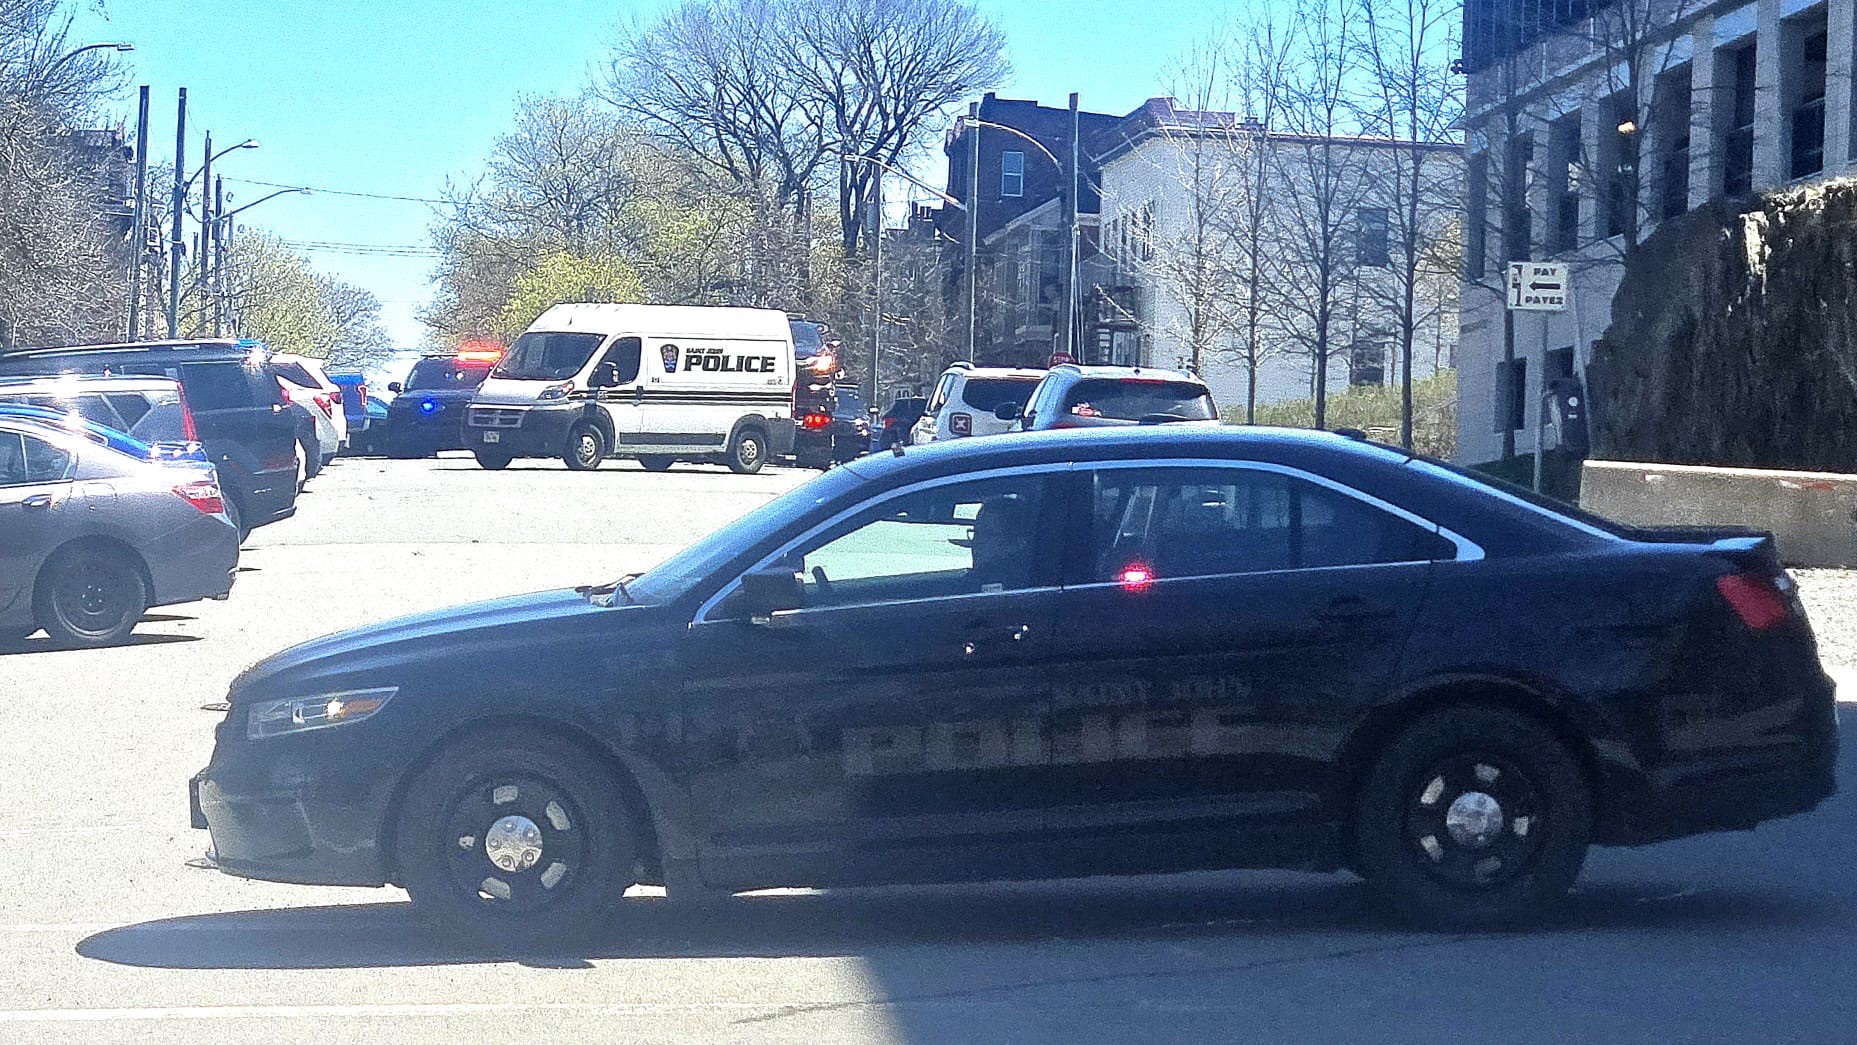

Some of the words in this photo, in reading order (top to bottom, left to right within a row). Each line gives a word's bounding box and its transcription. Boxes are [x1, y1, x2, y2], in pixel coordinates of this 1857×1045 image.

[1533, 267, 1557, 276] PAY
[1525, 295, 1563, 305] PAYEZ
[684, 355, 775, 373] POLICE
